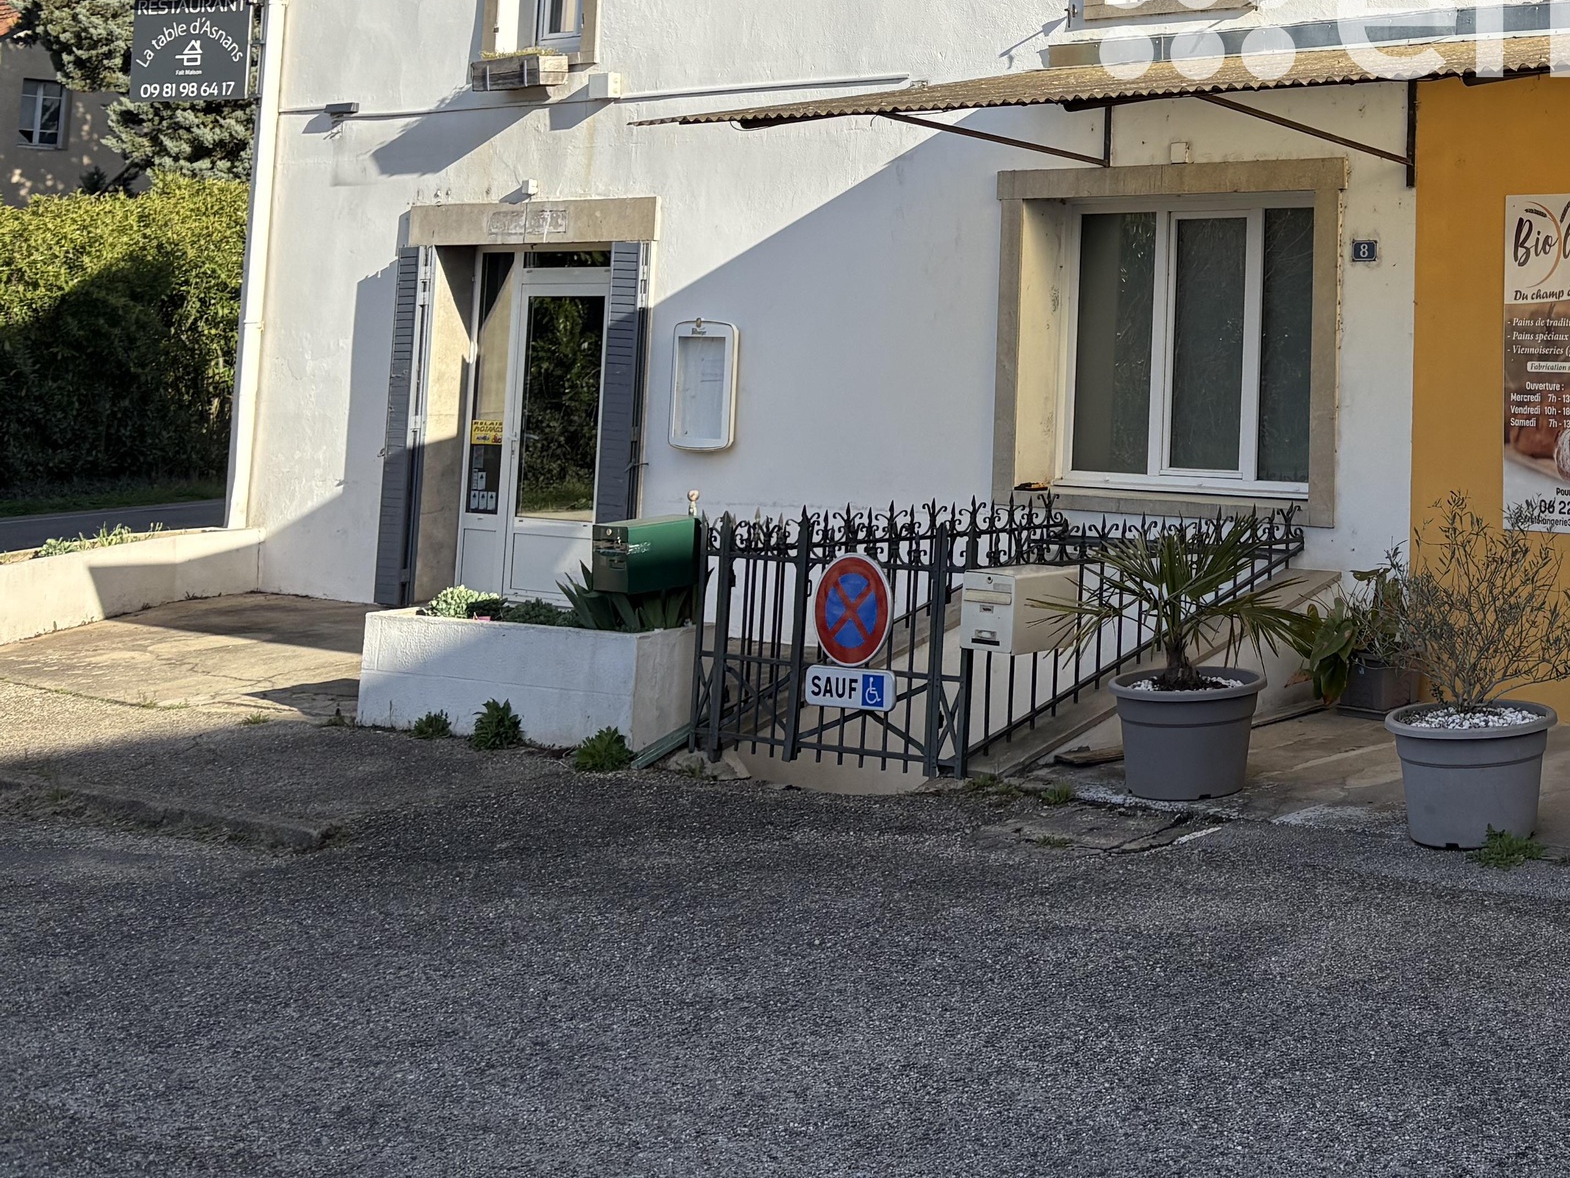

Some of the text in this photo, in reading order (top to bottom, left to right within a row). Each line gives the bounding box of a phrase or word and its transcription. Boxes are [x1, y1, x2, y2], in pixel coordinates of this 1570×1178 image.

[136, 17, 243, 68] La table d'Asnans
[140, 82, 235, 98] 09 81 98 64 17
[1360, 244, 1368, 257] 8
[1514, 290, 1528, 300] Du
[1531, 289, 1564, 300] champ
[1512, 318, 1534, 326] Pains
[1536, 318, 1544, 326] de
[1512, 332, 1534, 340] Pains
[1535, 331, 1569, 343] spéciaux
[1512, 345, 1563, 354] Viennoiseries
[1530, 363, 1566, 371] Fabrication
[1526, 382, 1560, 390] Ouverture
[1510, 393, 1541, 402] Mercredi
[1548, 394, 1556, 402] 7h
[1510, 405, 1540, 414] Vendredi
[1544, 406, 1556, 415] 10h
[1510, 418, 1536, 427] Samedi
[1549, 419, 1557, 428] 7h
[1539, 499, 1555, 514] 06
[811, 675, 858, 699] SAUF
